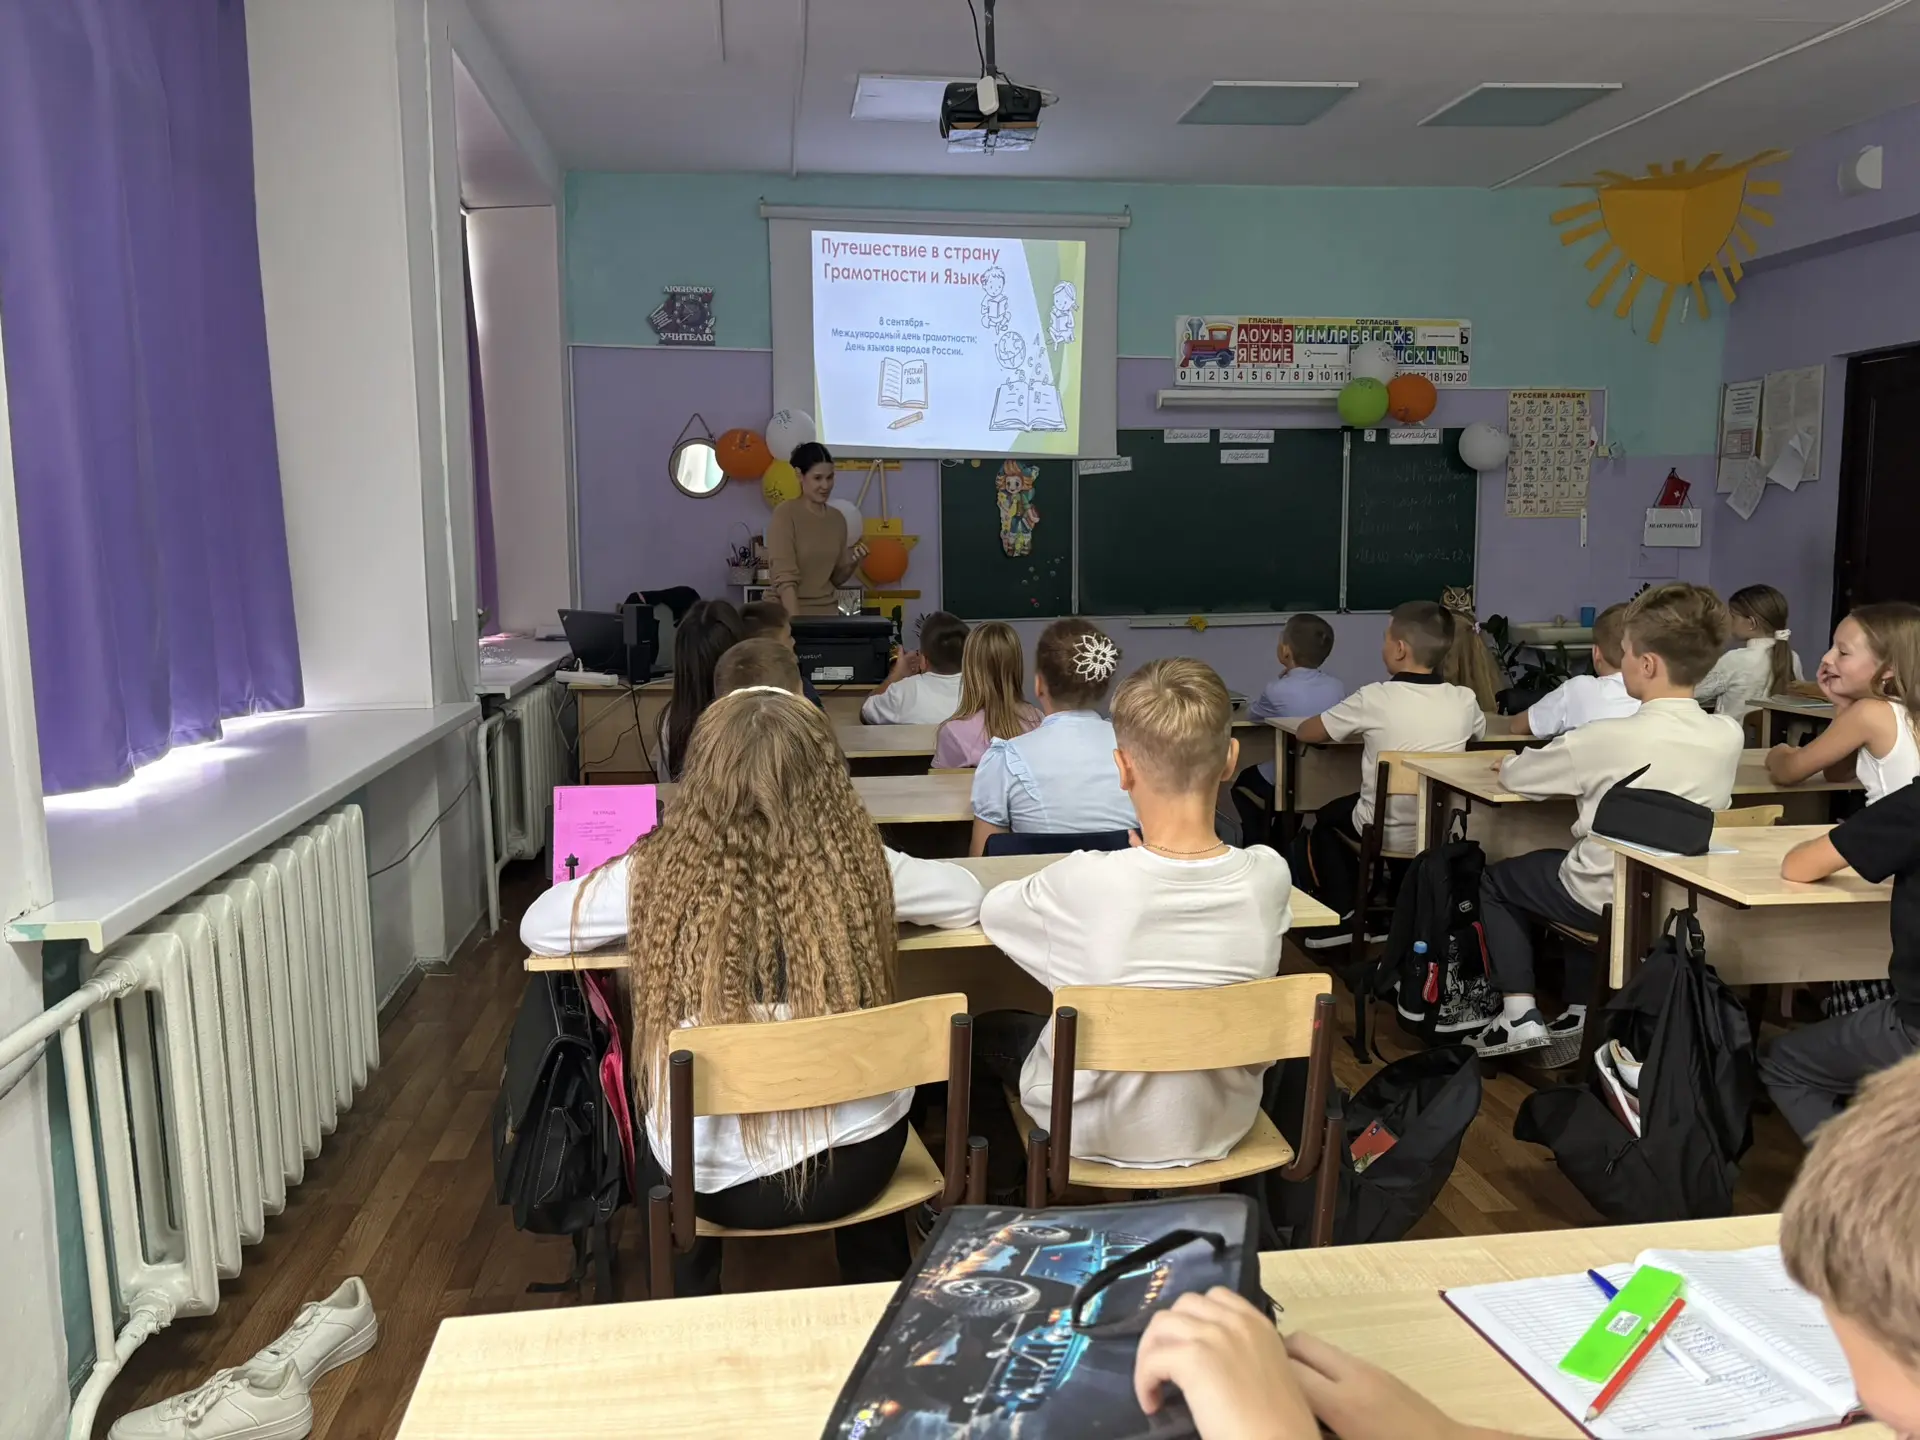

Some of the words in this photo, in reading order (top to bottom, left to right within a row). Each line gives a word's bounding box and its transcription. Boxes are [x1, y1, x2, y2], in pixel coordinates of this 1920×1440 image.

[822, 238, 926, 258] Путешествие
[932, 248, 939, 259] в
[944, 246, 1000, 264] страну
[824, 263, 926, 283] Грамотности
[931, 272, 939, 284] и
[879, 316, 884, 326] 8
[886, 318, 924, 329] сентября
[660, 332, 714, 342] УЧИТЕЛЮ
[831, 328, 900, 340] Международный
[902, 332, 921, 341] день
[845, 341, 866, 351] День
[867, 344, 895, 352] языков
[896, 345, 931, 355] народов
[1180, 371, 1186, 380] 0
[1195, 371, 1200, 380] 1
[1209, 371, 1215, 380] 2
[1223, 371, 1229, 380] 3
[1237, 371, 1243, 380] 4
[1252, 371, 1257, 380] 5
[1265, 371, 1271, 380] 6
[1280, 371, 1285, 380] 7
[1294, 371, 1299, 380] 8
[1308, 371, 1313, 380] 9
[1319, 371, 1330, 380] 10
[1334, 371, 1343, 380] 11
[1429, 372, 1439, 382] 18
[1443, 372, 1453, 382] 19
[1456, 372, 1467, 382] 20
[1389, 429, 1438, 443] сентября
